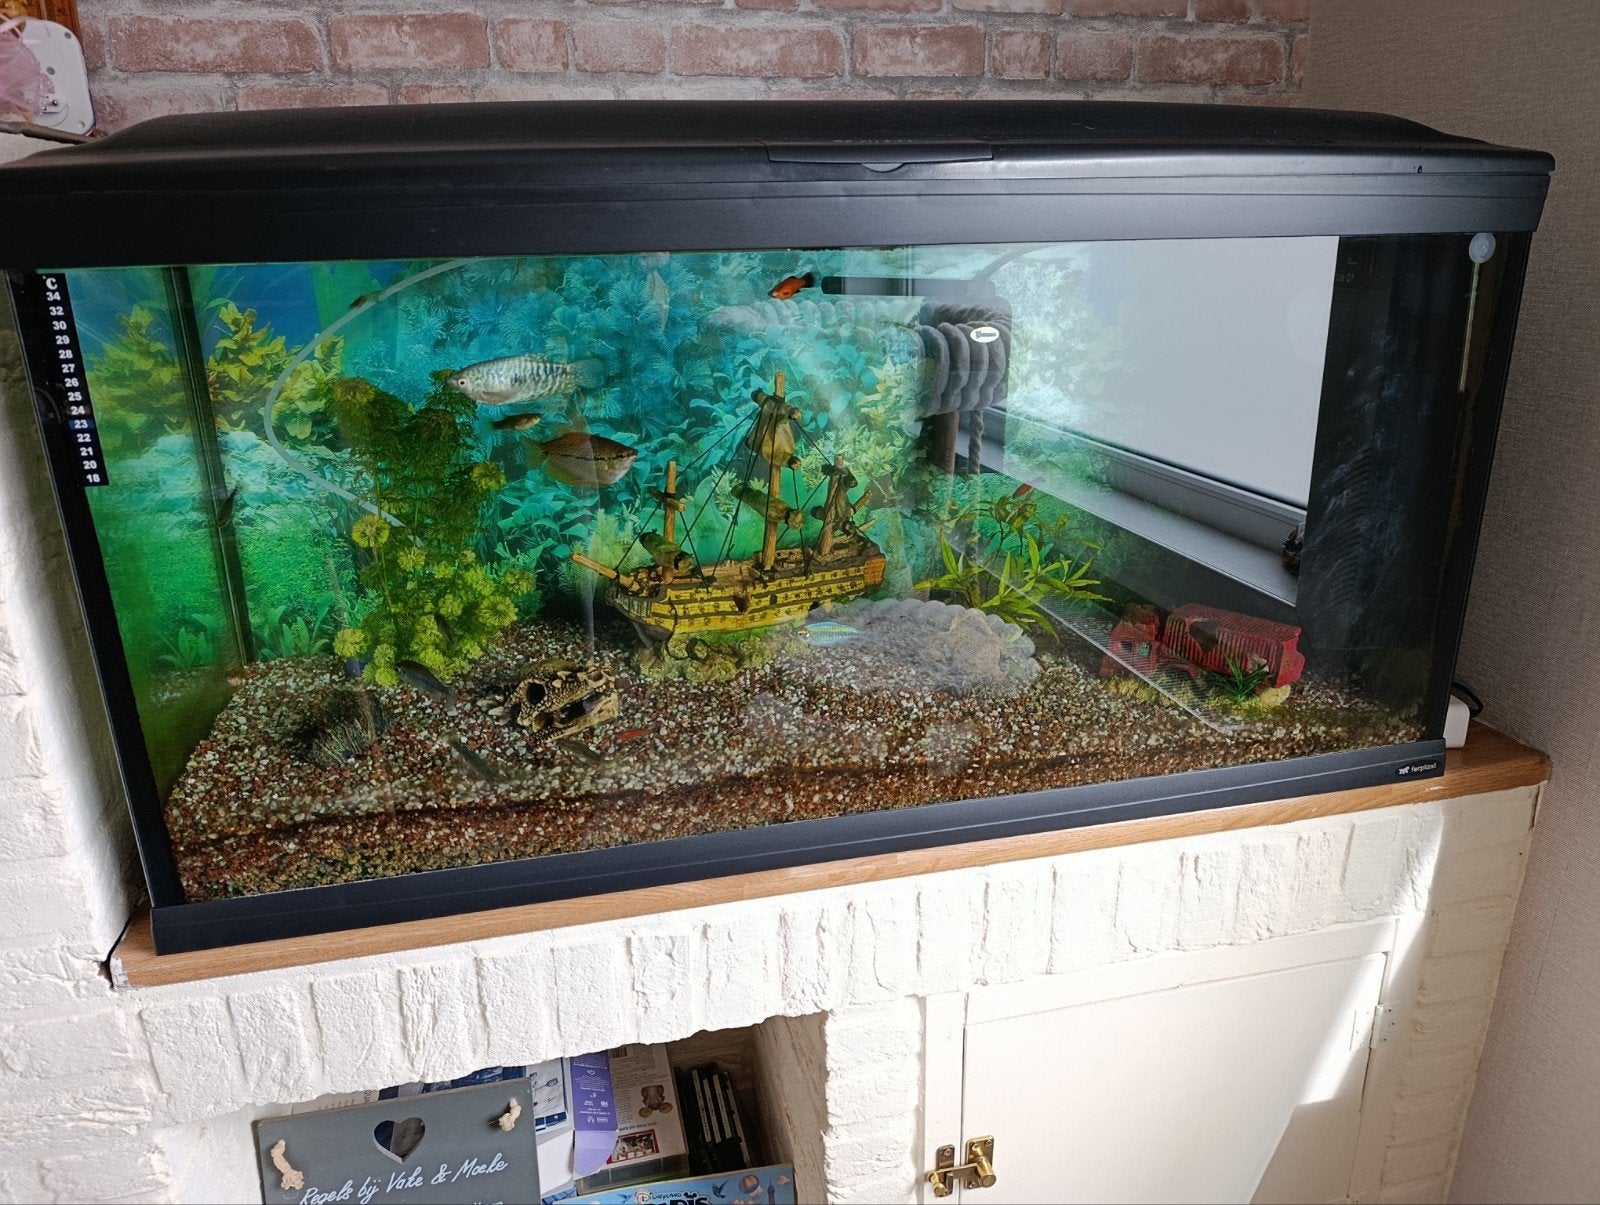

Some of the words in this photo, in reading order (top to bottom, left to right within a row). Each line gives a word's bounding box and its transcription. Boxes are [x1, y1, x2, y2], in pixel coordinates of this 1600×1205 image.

[47, 291, 61, 300] 34
[50, 307, 64, 315] 32
[53, 321, 66, 330] 30
[56, 335, 69, 344] 29
[59, 350, 72, 358] 28
[62, 364, 75, 373] 27
[65, 378, 78, 387] 26
[68, 392, 82, 401] 25
[71, 406, 85, 415] 24
[75, 420, 88, 428] 23
[77, 433, 91, 442] 22
[80, 447, 93, 456] 21
[83, 461, 97, 469] 20
[87, 474, 100, 482] 18
[1411, 762, 1437, 772] ferplast
[301, 1180, 353, 1205] Regels
[431, 1164, 452, 1185] &
[451, 1152, 509, 1182] Moeke
